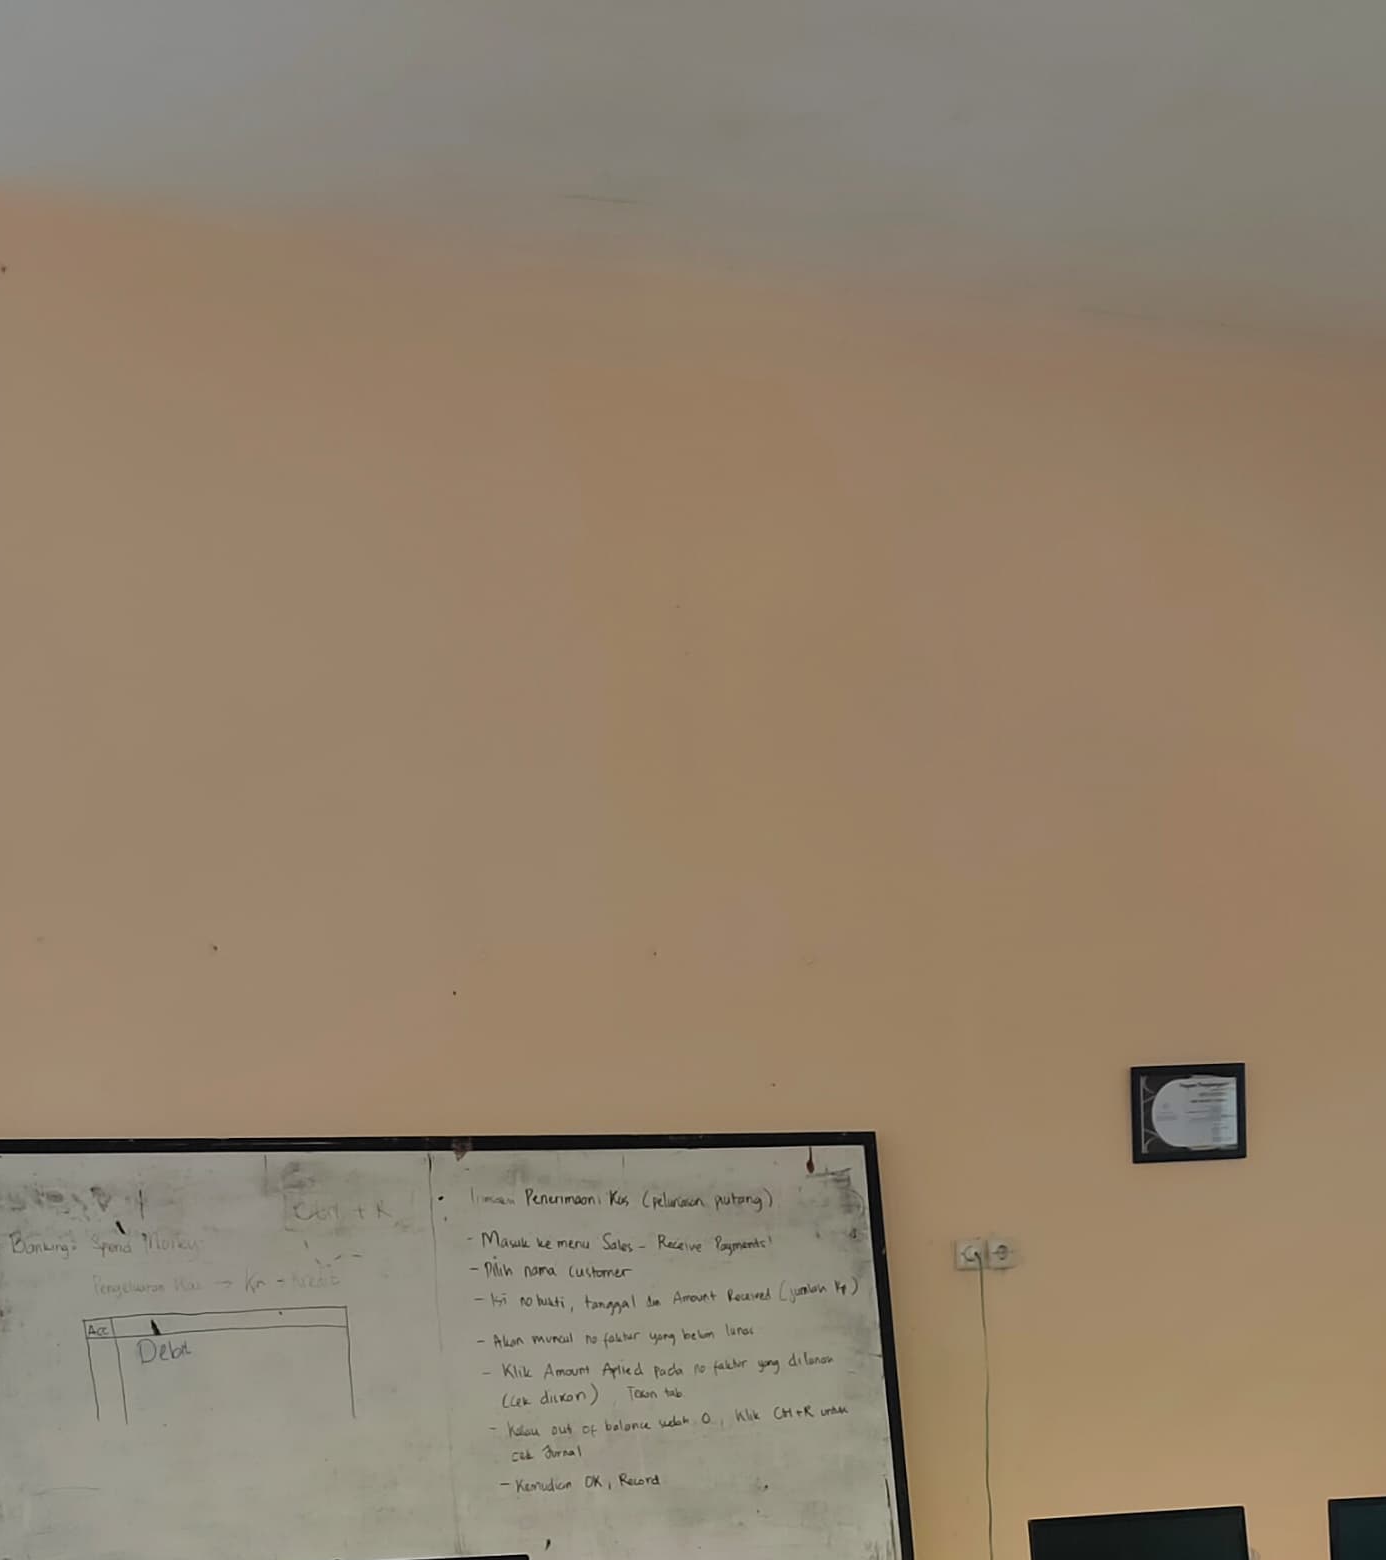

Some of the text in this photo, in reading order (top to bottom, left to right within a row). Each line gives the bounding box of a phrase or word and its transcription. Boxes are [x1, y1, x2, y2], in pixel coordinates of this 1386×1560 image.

[481, 1230, 530, 1249] Masuk
[536, 1236, 552, 1249] ke
[557, 1239, 590, 1249] menu
[602, 1232, 633, 1252] Sales
[658, 1234, 702, 1252] Receive
[524, 1263, 557, 1278] nama
[585, 1294, 636, 1316] tanggal
[673, 1290, 716, 1304] Amount
[493, 1333, 524, 1349] Akan
[531, 1331, 573, 1345] muncul
[585, 1334, 597, 1344] no
[603, 1331, 640, 1349] faktur
[649, 1331, 676, 1347] yang
[502, 1362, 533, 1379] Klik
[544, 1363, 590, 1380] Amount
[653, 1362, 683, 1379] pada
[694, 1363, 706, 1374] no
[714, 1357, 748, 1376] faktur
[757, 1357, 780, 1375] yang
[664, 1387, 683, 1399] tab
[551, 1423, 573, 1436] out
[582, 1423, 598, 1438] of
[605, 1418, 651, 1432] balance
[618, 1473, 661, 1488] Record
